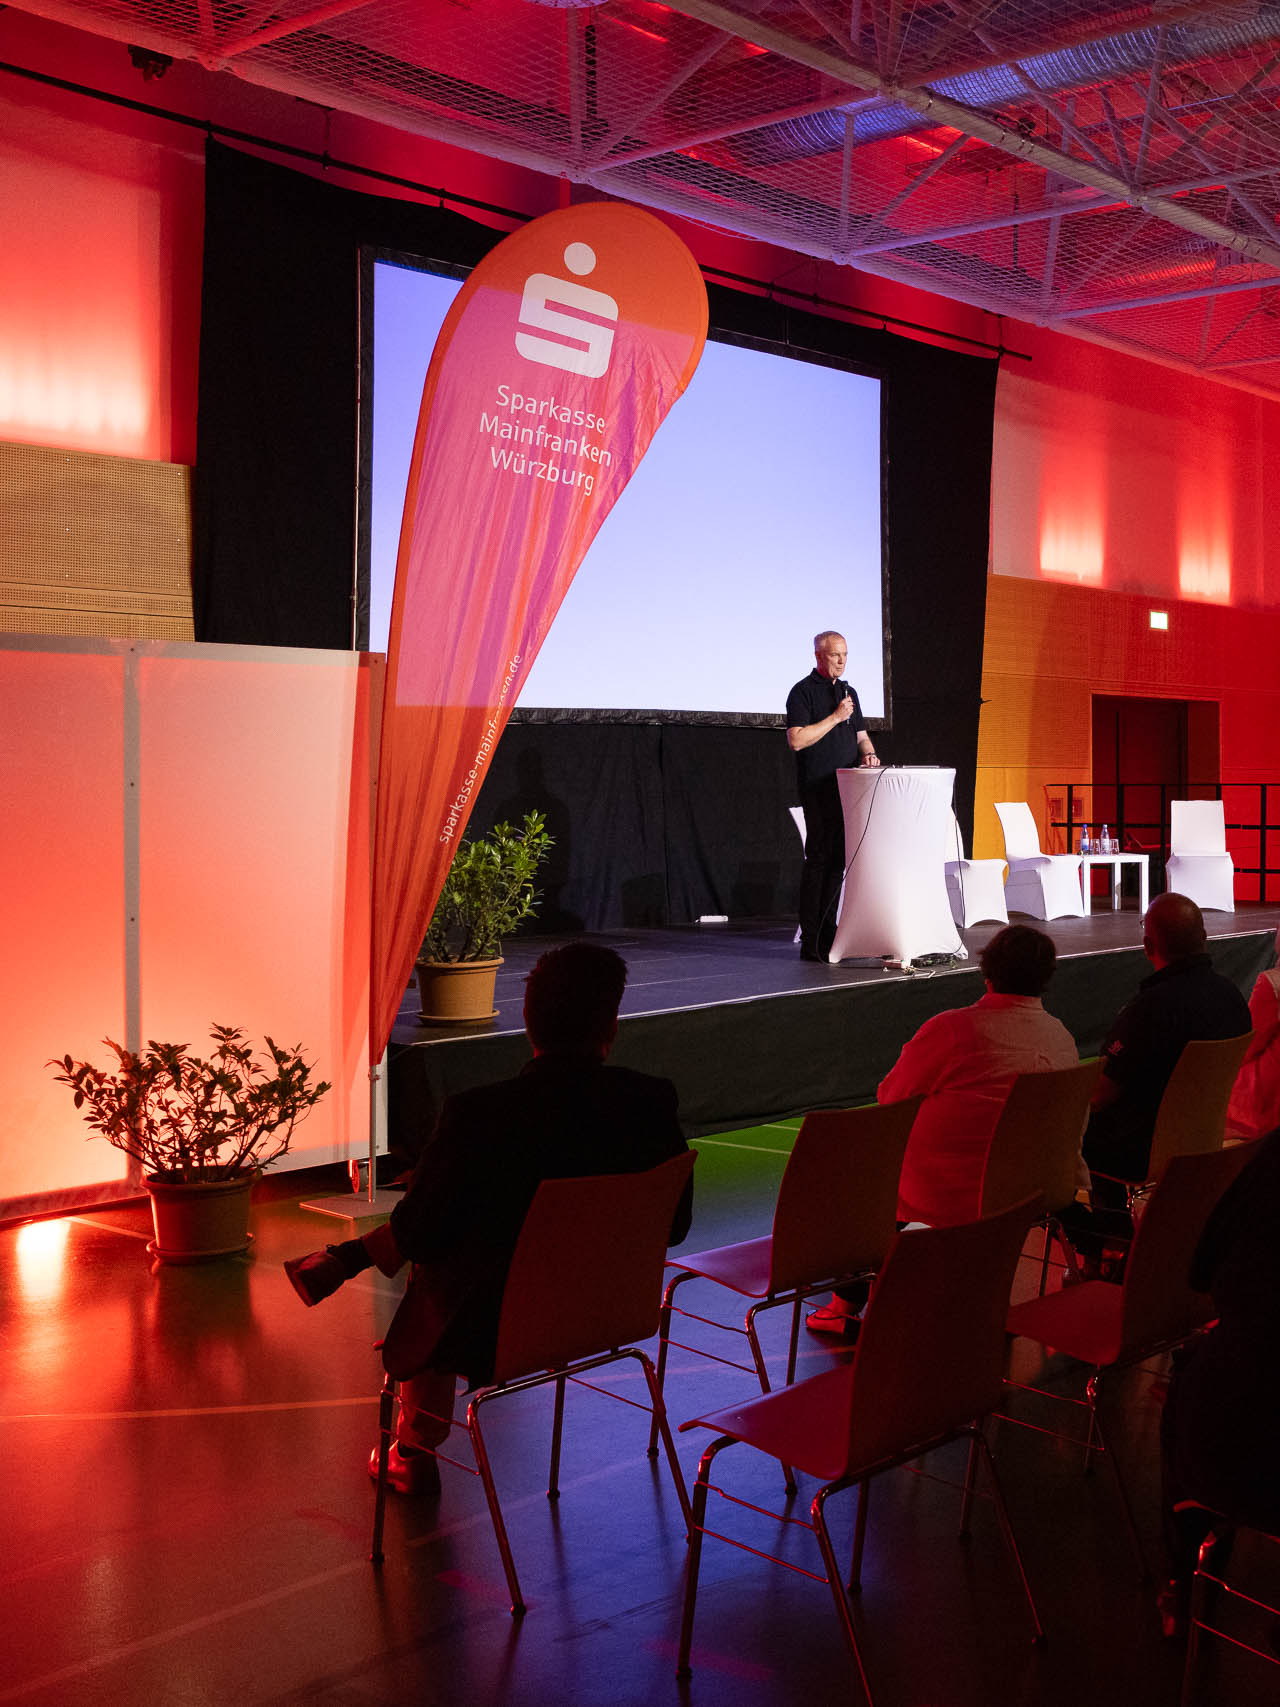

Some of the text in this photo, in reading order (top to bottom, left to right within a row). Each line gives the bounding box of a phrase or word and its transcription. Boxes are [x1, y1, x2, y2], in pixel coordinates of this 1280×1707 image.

[495, 384, 606, 434] Sparkasse
[479, 412, 612, 467] Mainfranken
[490, 446, 595, 497] Würzburg
